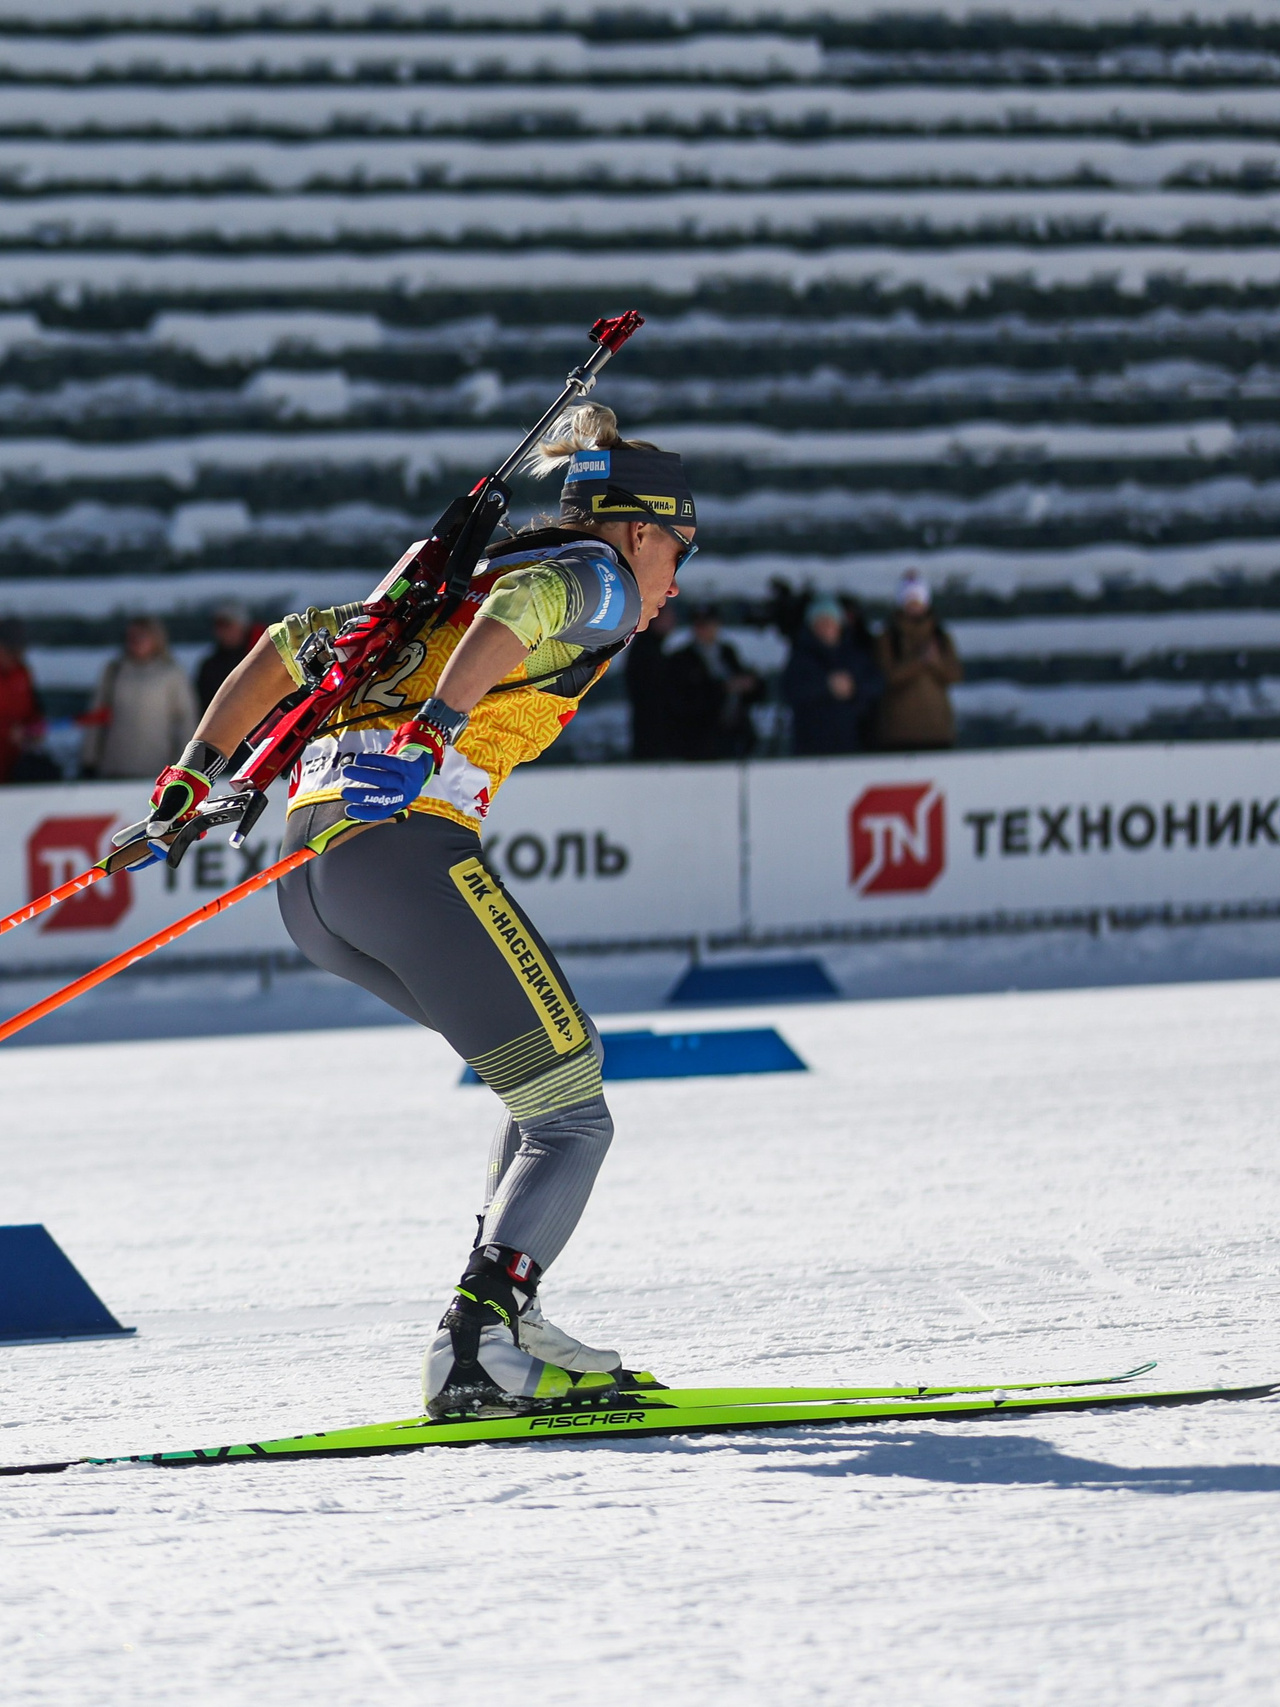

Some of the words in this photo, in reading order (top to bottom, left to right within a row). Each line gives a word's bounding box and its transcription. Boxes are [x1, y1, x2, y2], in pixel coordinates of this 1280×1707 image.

[964, 799, 1280, 858] ТЕХНОНИК
[463, 871, 493, 902] ЛК
[488, 904, 573, 1042] «НАСЕДКИНА»
[529, 1412, 646, 1430] FISCHER
